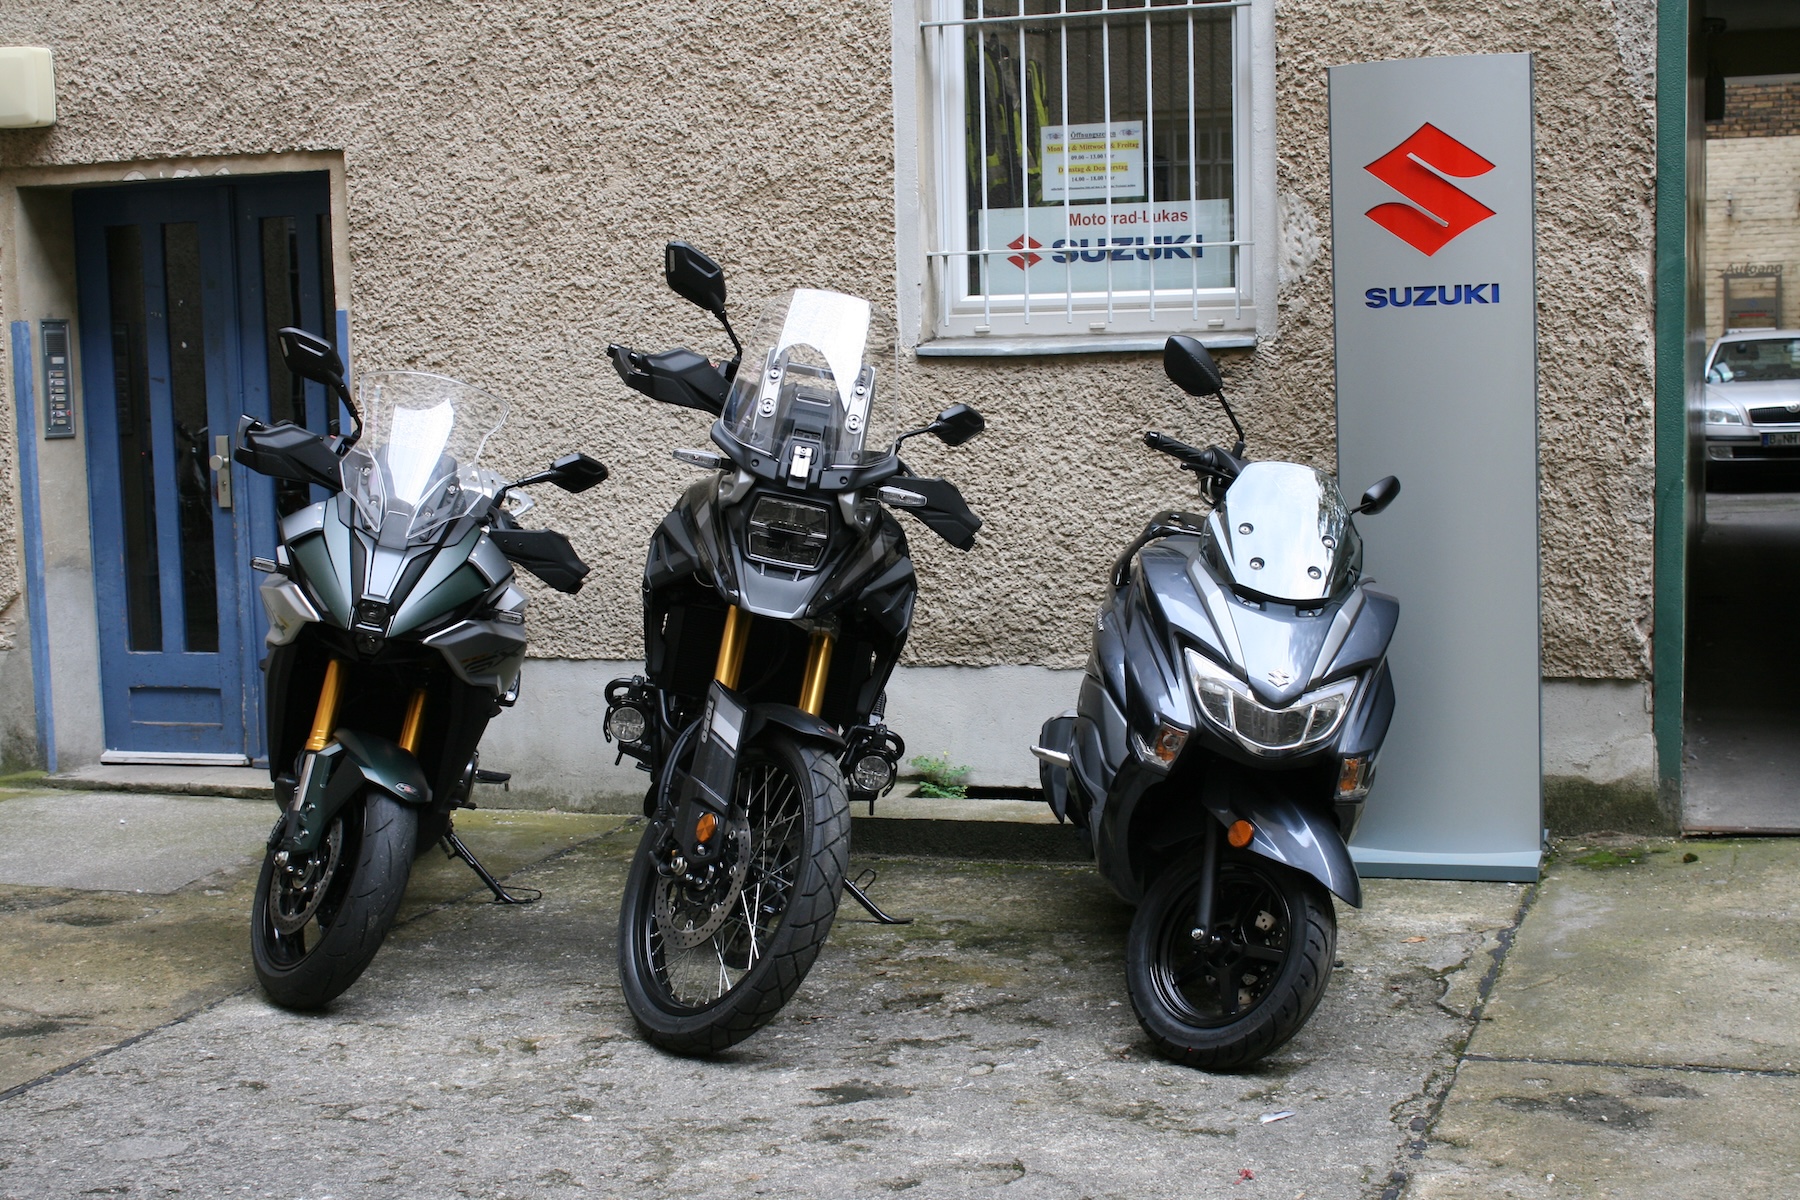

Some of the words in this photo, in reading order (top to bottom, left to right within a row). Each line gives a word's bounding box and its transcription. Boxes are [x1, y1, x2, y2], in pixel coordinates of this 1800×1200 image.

[1070, 131, 1116, 139] Öffnungszeen
[1117, 140, 1139, 149] Freitag
[1094, 163, 1128, 172] Donrstag
[1069, 209, 1188, 226] Motorad-Lukas
[1052, 234, 1203, 263] SUZUKI
[1364, 283, 1500, 308] SUZUKI
[700, 700, 714, 744] 1050
